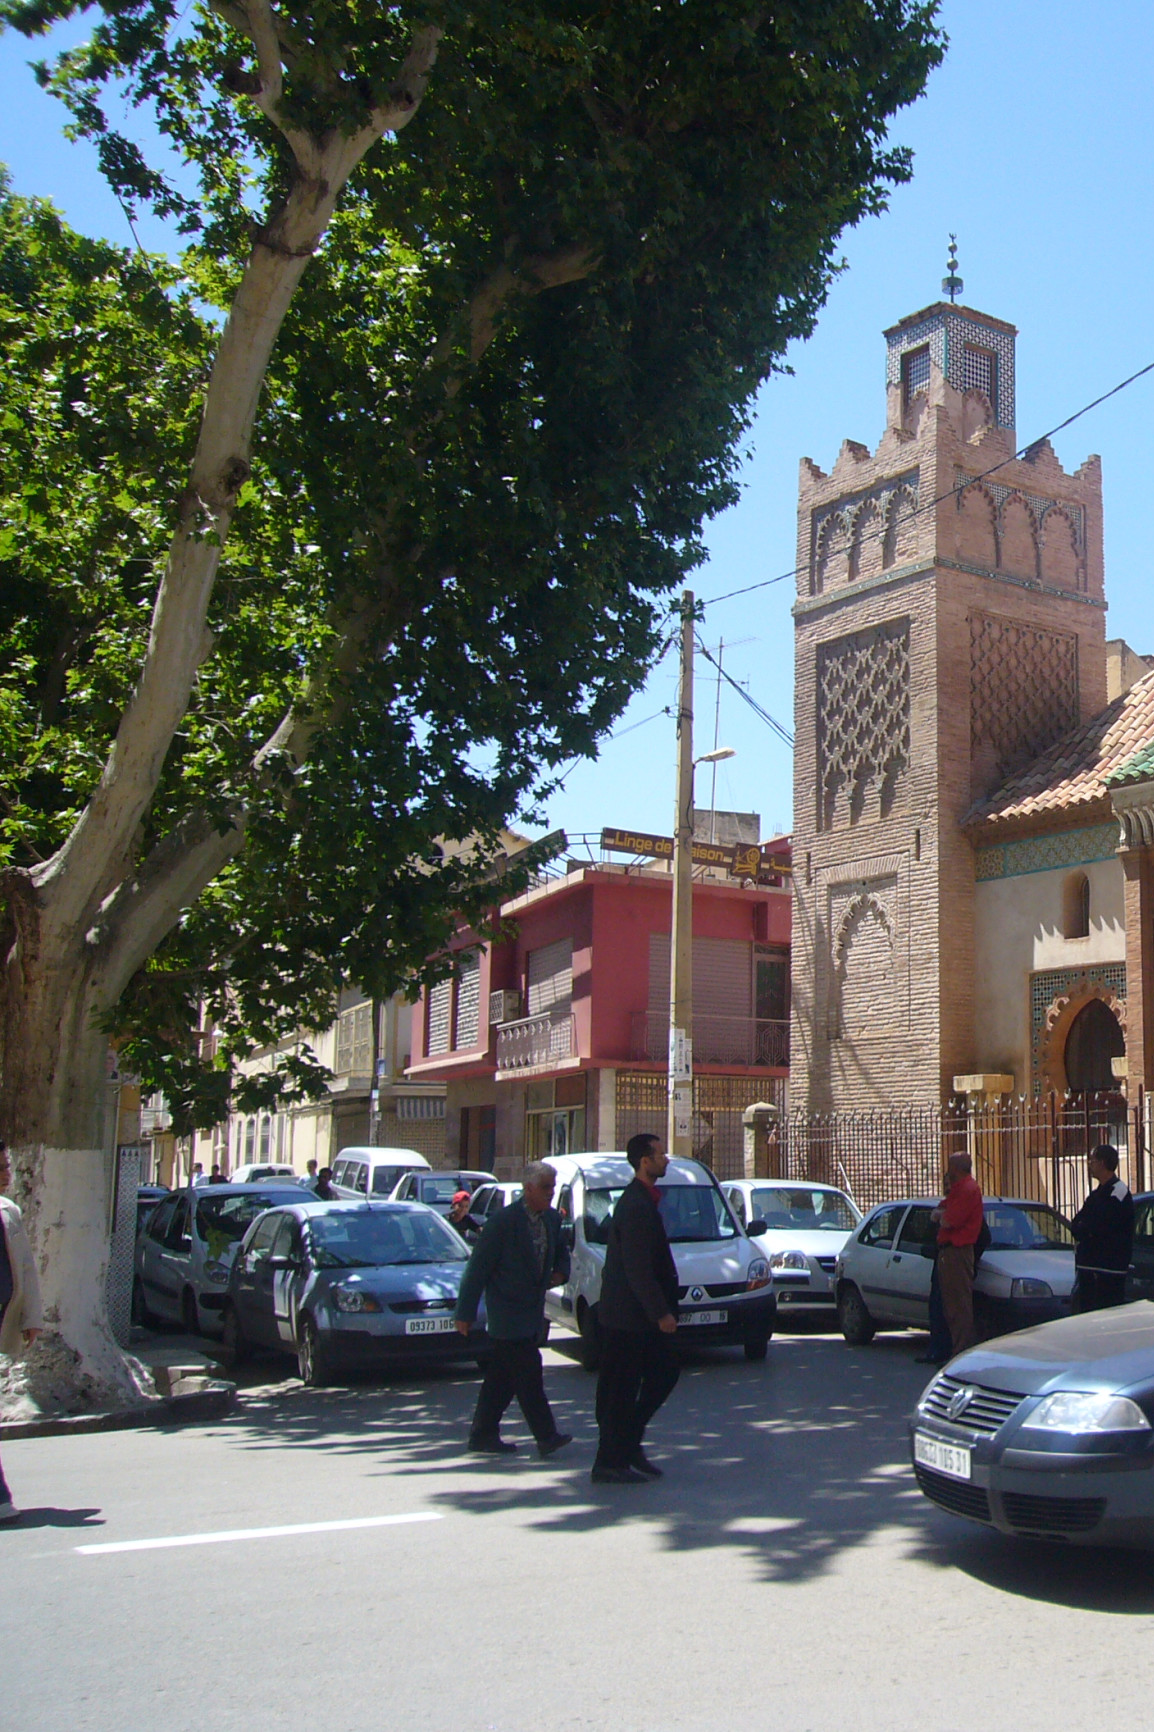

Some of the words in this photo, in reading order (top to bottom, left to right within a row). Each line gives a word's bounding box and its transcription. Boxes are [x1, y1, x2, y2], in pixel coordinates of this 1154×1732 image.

[615, 832, 654, 853] Linge
[655, 839, 673, 854] de
[691, 844, 724, 861] aison
[409, 1320, 436, 1332] 09373
